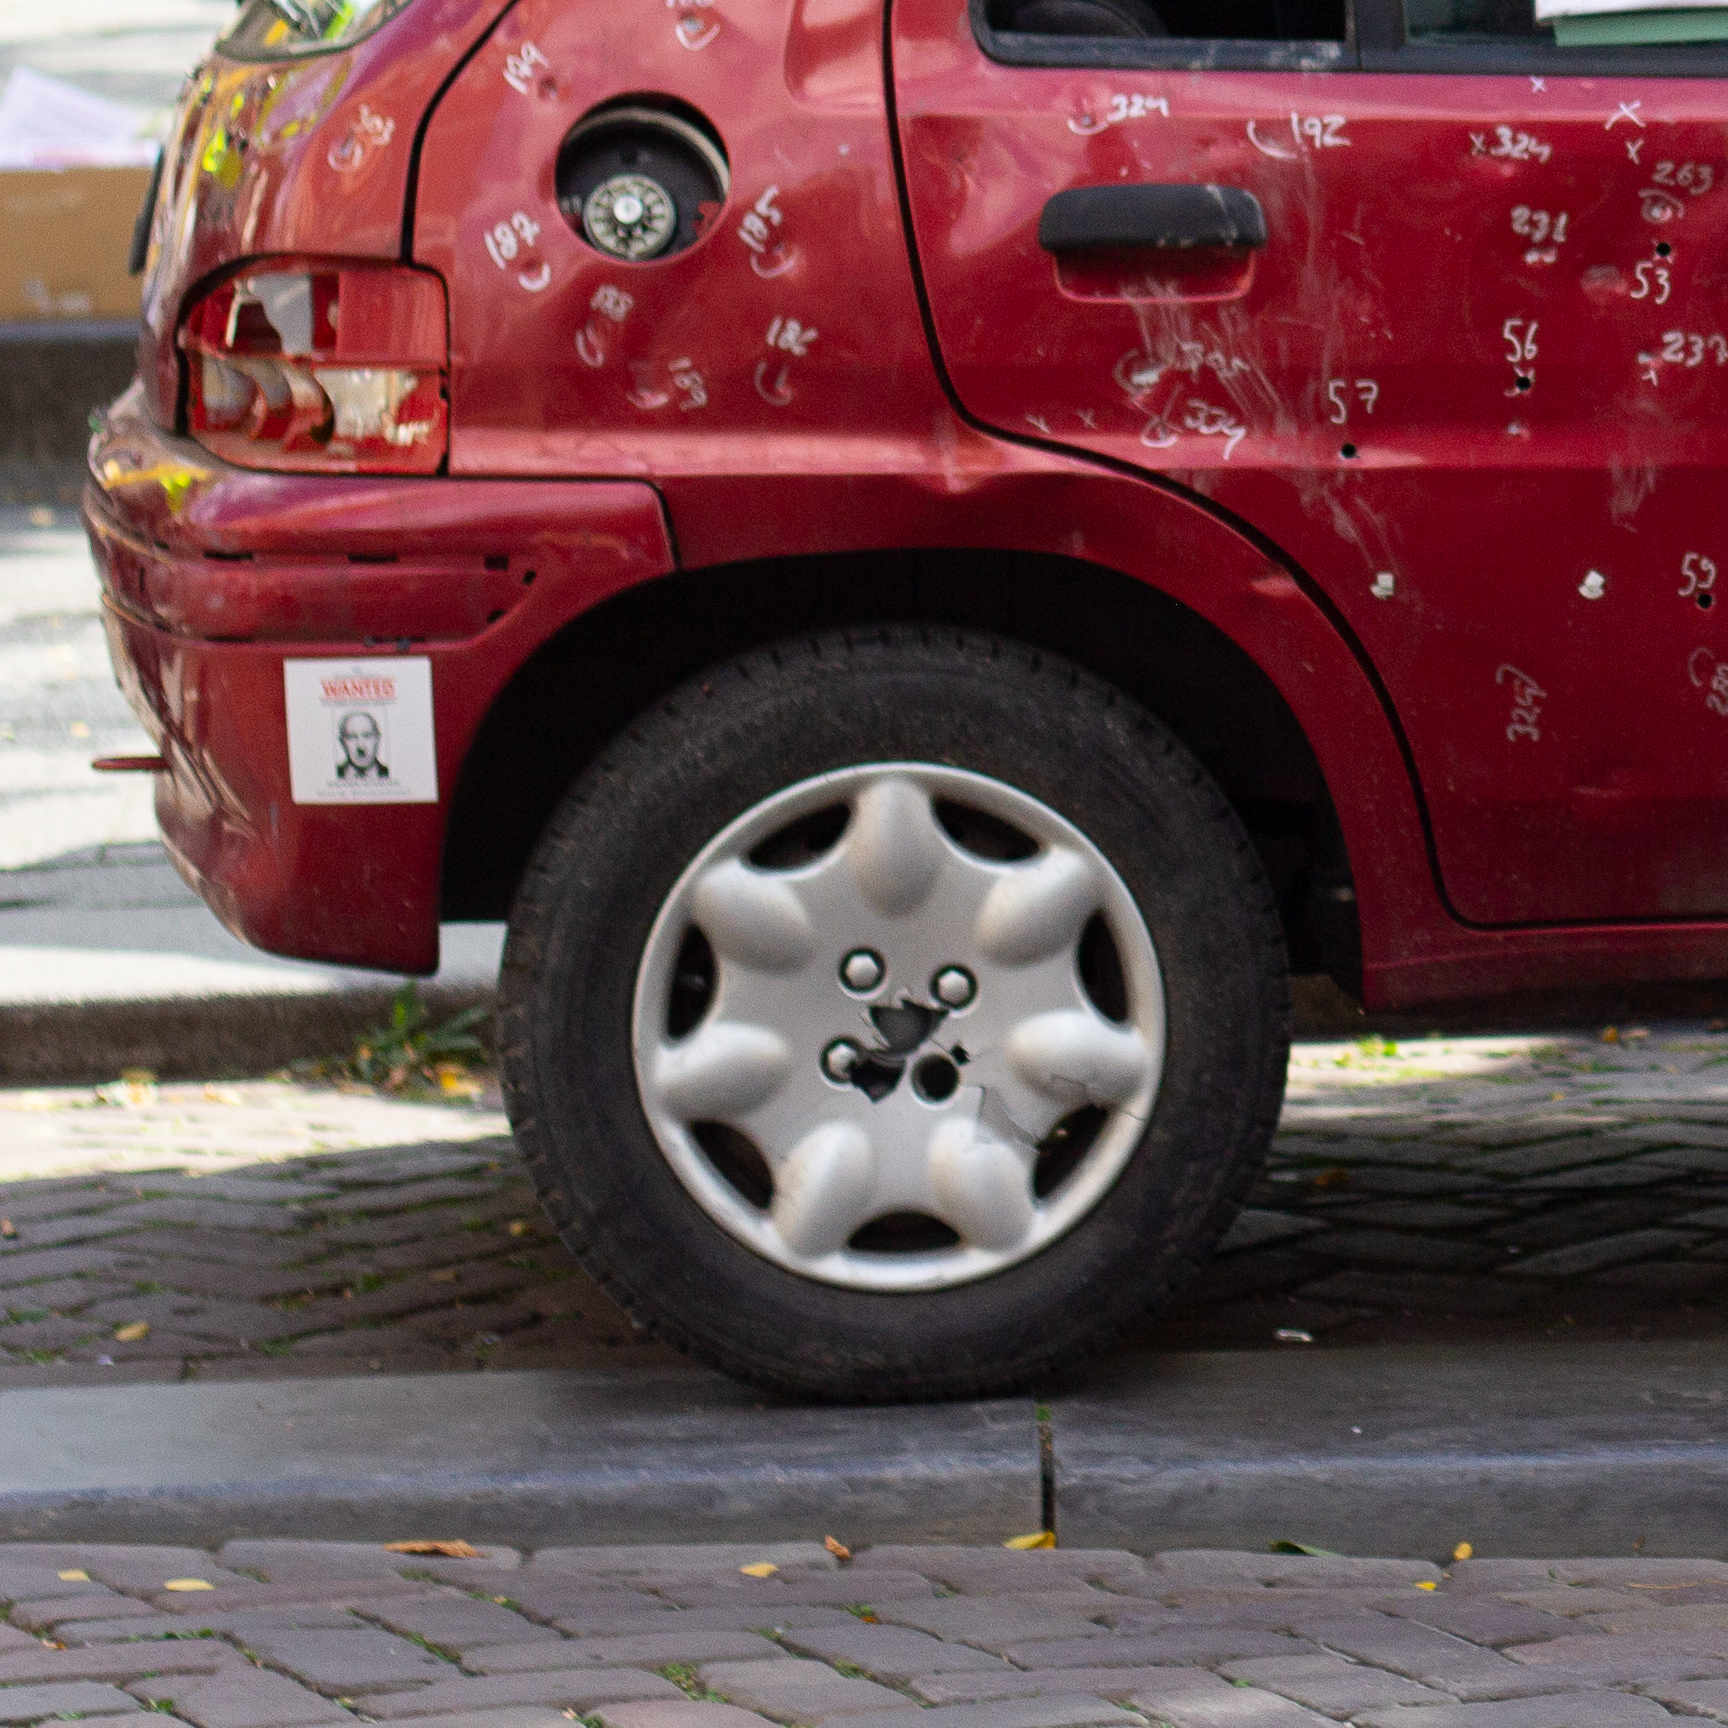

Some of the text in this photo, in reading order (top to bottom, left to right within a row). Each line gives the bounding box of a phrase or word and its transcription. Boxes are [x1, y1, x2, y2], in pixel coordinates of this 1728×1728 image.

[1630, 259, 1672, 305] 53
[1502, 317, 1540, 362] 56
[1328, 378, 1380, 424] 57
[1677, 550, 1718, 598] 59
